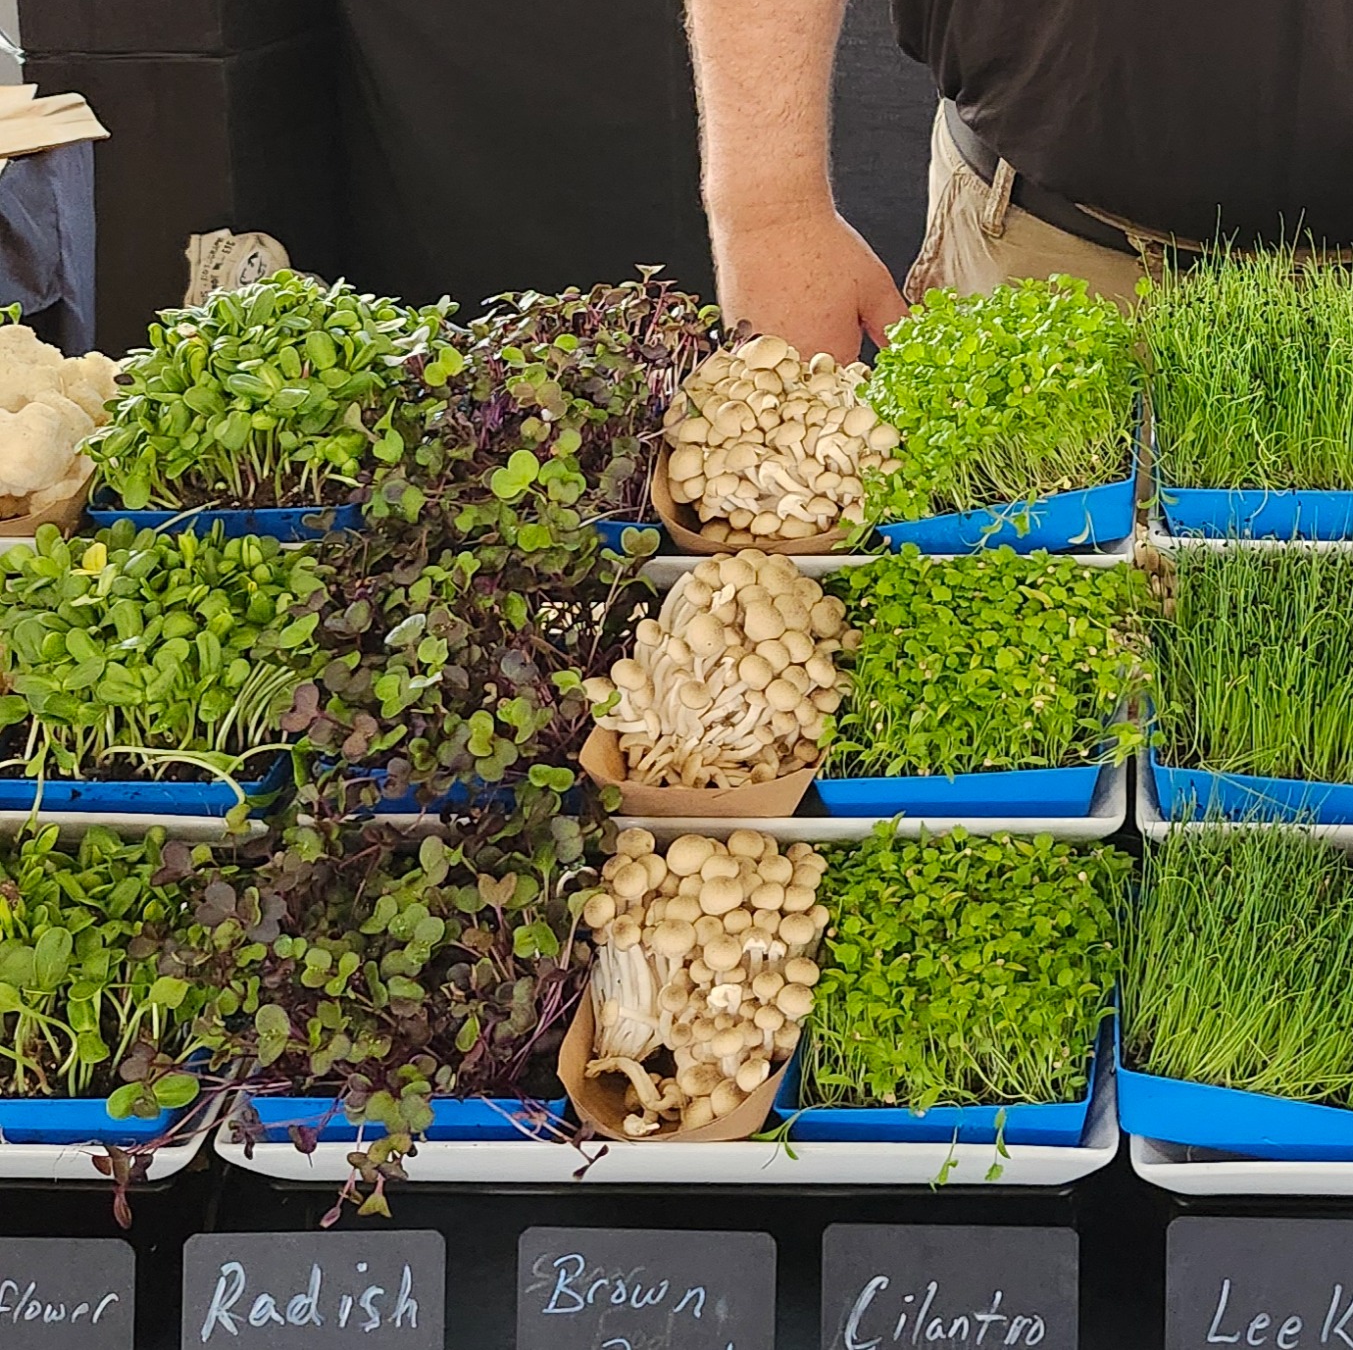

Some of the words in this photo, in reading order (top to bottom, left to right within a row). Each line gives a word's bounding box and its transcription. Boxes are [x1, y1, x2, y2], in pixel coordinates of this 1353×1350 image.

[200, 1261, 419, 1343] Radish
[541, 1253, 707, 1319] Brown
[844, 1275, 1046, 1350] Cilantro
